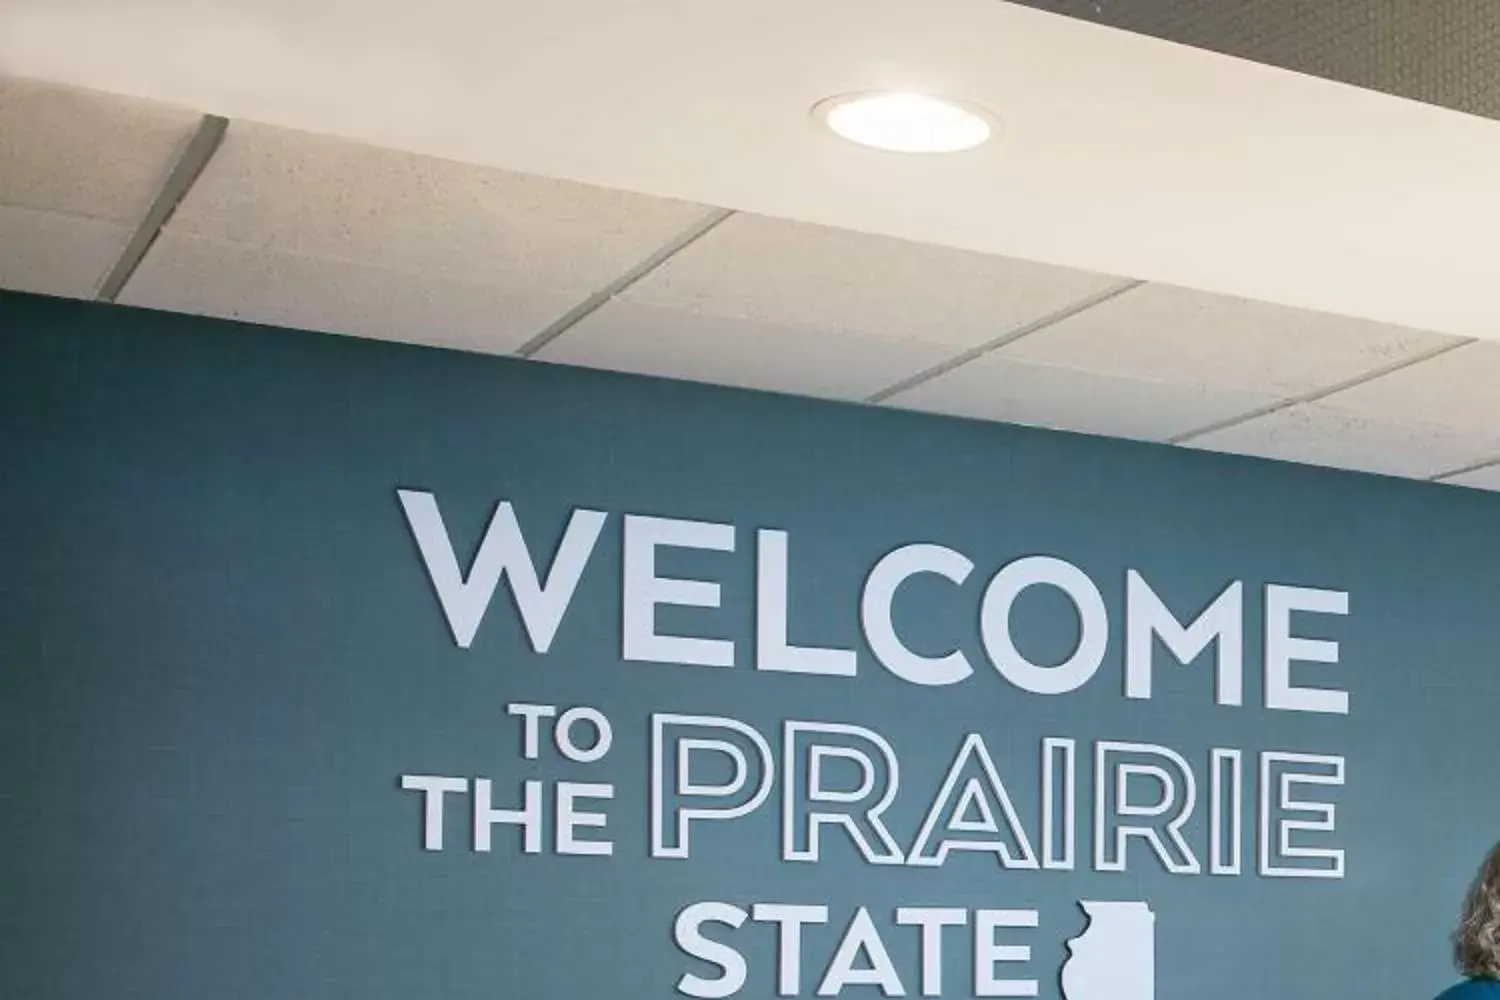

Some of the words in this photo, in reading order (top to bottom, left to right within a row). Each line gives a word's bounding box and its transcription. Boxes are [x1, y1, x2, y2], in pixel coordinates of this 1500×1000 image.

[397, 490, 1349, 714] WELCOME
[402, 775, 614, 856] THE
[652, 713, 1345, 879] PRAIRIE
[508, 702, 613, 763] TO
[675, 901, 1039, 999] STATE
